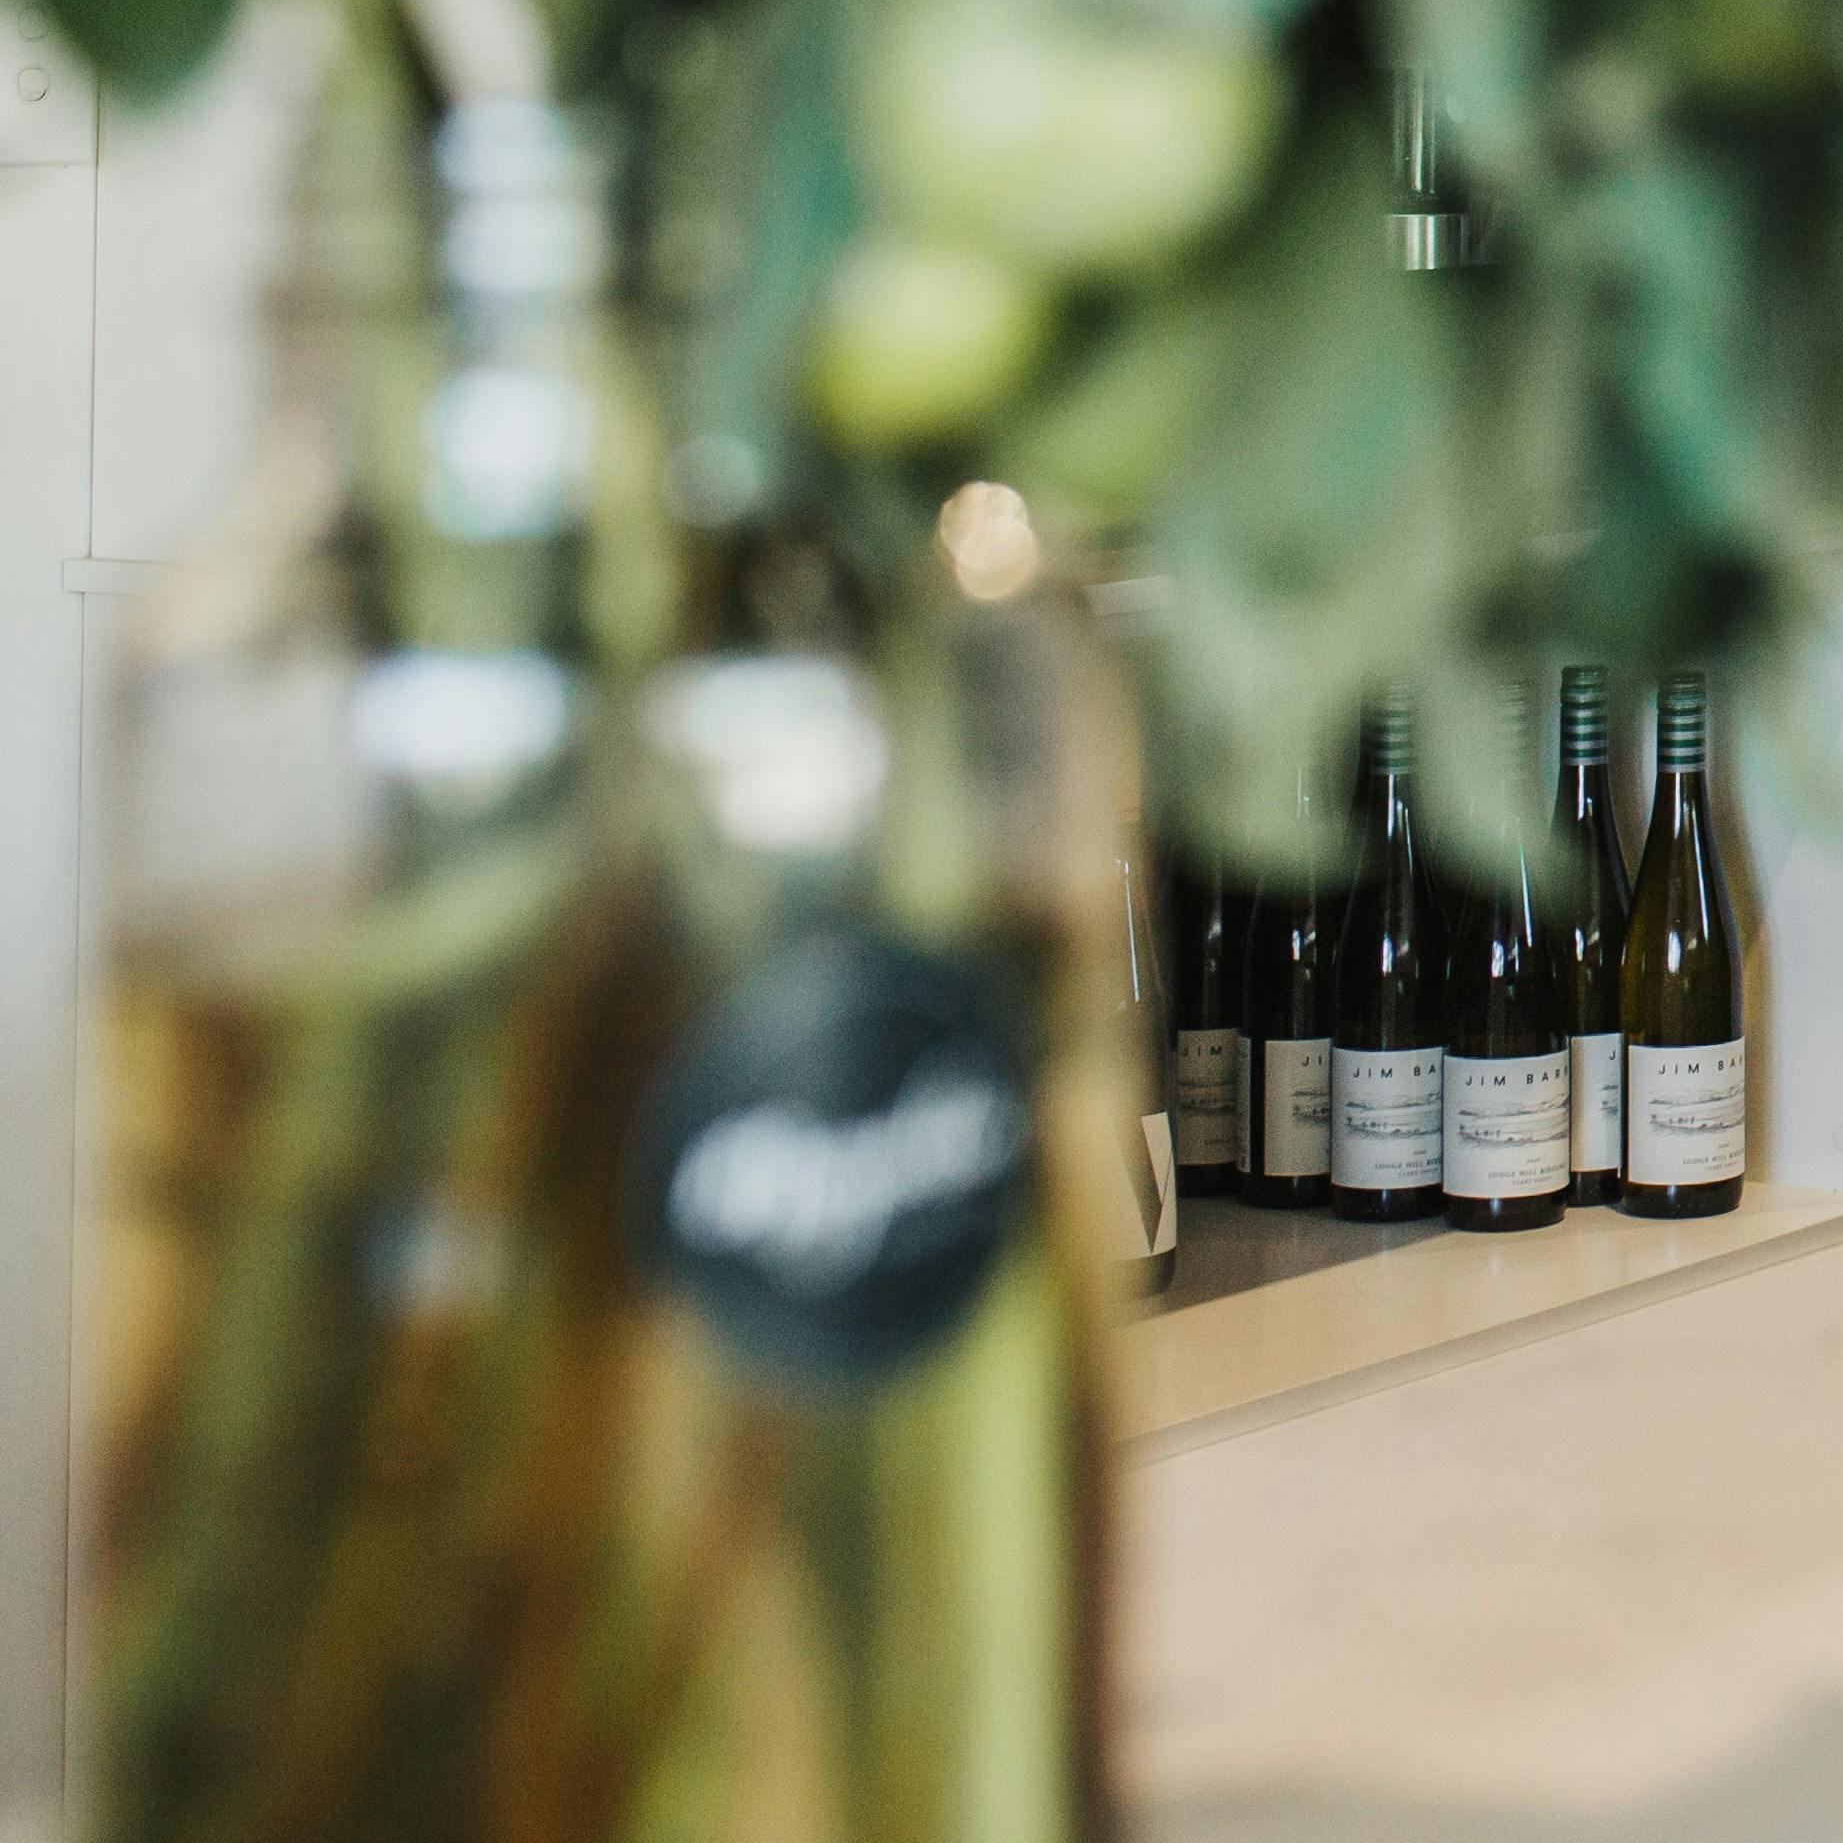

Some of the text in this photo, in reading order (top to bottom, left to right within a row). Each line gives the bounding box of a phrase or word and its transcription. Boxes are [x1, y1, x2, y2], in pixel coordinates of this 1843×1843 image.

[1353, 1067, 1393, 1079] JIM
[1659, 1062, 1700, 1075] JIM
[1466, 1074, 1506, 1086] JIM
